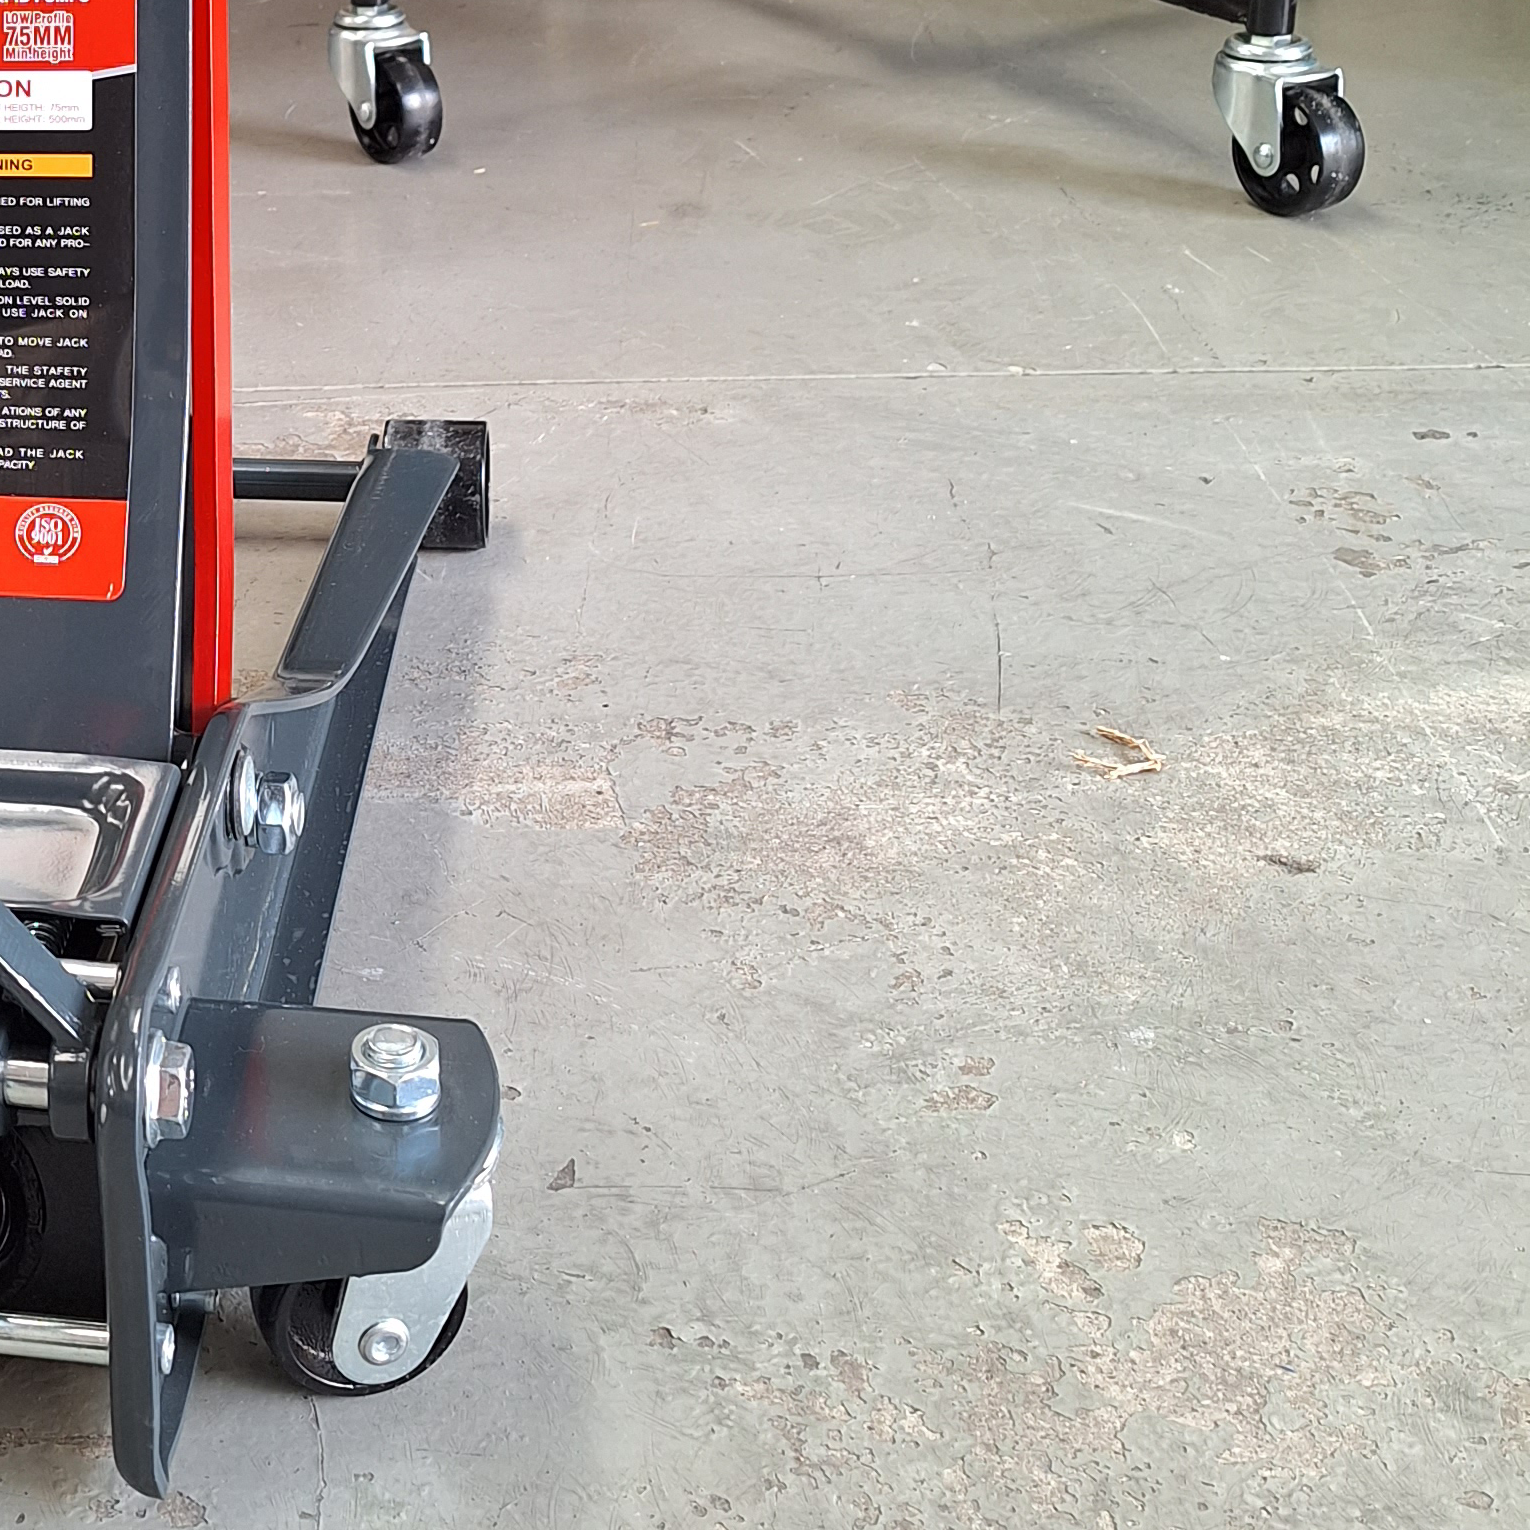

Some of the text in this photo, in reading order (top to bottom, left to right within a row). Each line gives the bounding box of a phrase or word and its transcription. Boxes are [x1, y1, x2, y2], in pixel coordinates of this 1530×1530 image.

[4, 26, 71, 46] 75MM
[20, 197, 43, 206] FOR
[47, 198, 90, 206] LIFTING
[25, 226, 41, 235] AS
[45, 227, 53, 235] A
[58, 227, 89, 235] JACK
[10, 239, 32, 247] FOR
[35, 239, 57, 247] ANY
[61, 239, 90, 247] PRO-
[23, 268, 45, 276] USE
[48, 268, 90, 277] SAFETY
[0, 280, 31, 288] LOAD.
[17, 296, 51, 305] LEVEL
[55, 297, 89, 305] SOLID
[2, 308, 26, 317] USE
[32, 309, 64, 317] JACK
[69, 309, 87, 318] ON
[18, 337, 52, 346] MOVE
[57, 338, 88, 347] JACK
[6, 366, 29, 374] THE
[33, 366, 88, 375] STAFETY
[48, 379, 88, 388] AGENT
[2, 407, 42, 416] ATIONS
[45, 408, 61, 416] OF
[63, 408, 87, 417] ANY
[70, 421, 86, 429] OF
[20, 448, 44, 457] THE
[50, 449, 84, 458] JACK
[31, 530, 62, 544] 9001
